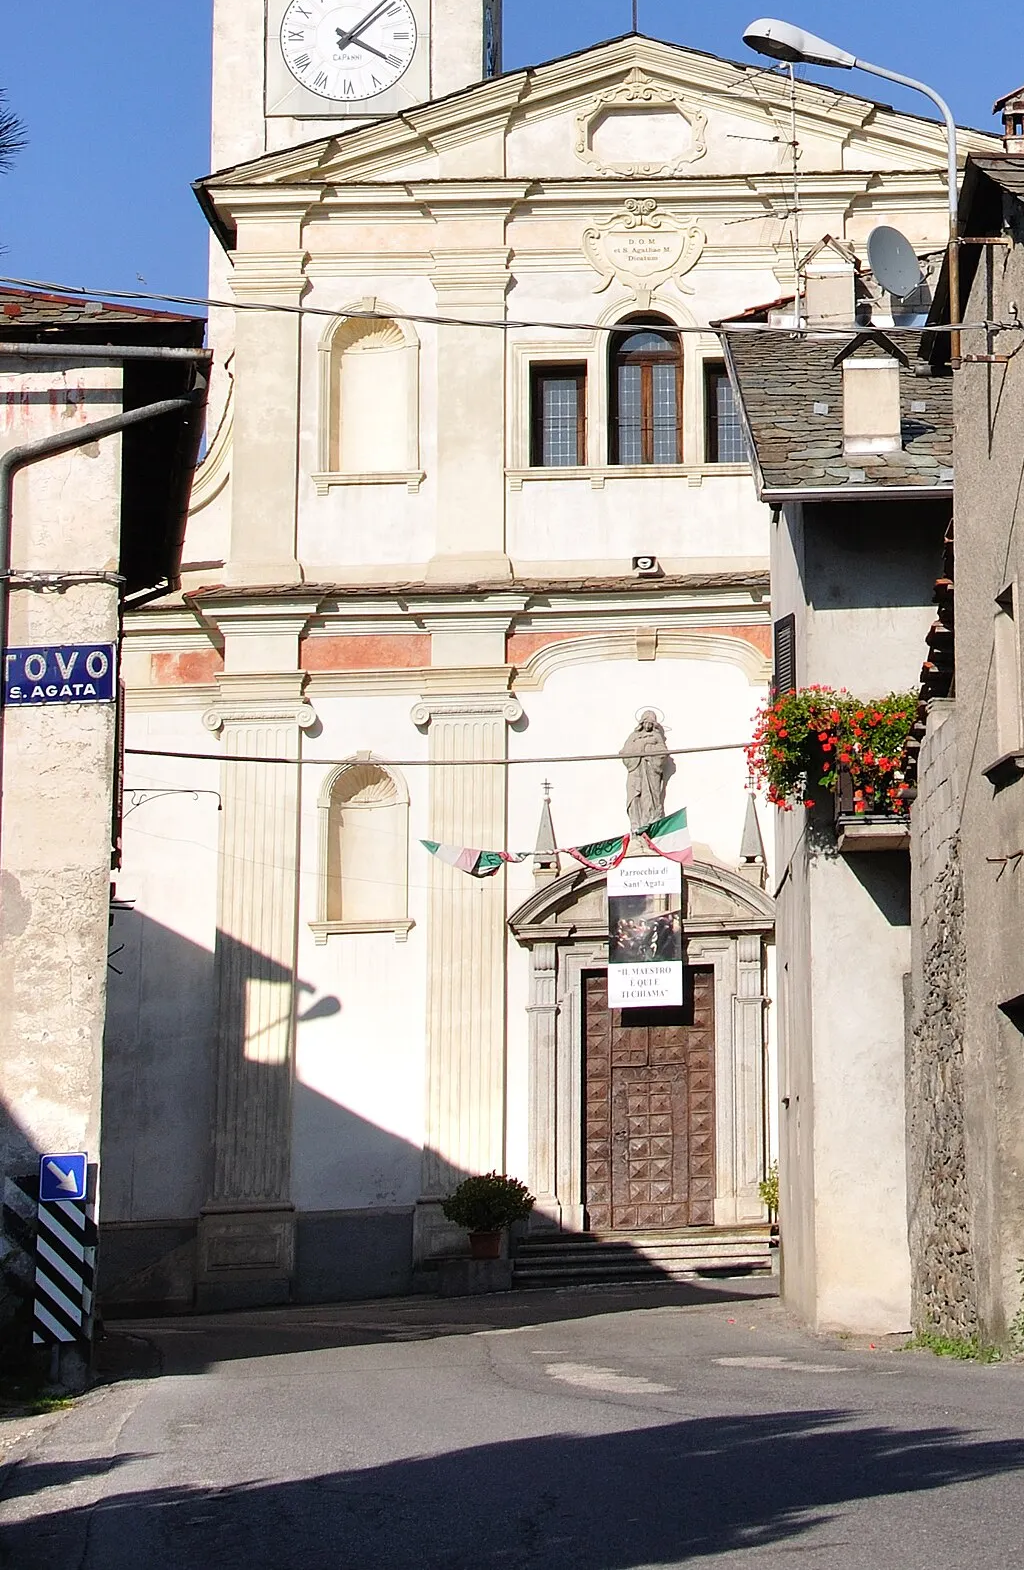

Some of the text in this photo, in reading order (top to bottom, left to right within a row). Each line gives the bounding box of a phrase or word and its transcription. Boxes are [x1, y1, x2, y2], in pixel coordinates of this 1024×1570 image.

[295, 5, 312, 19] X
[287, 30, 305, 41] IX
[393, 32, 409, 40] III
[293, 53, 311, 73] VIII
[313, 70, 328, 90] VII
[343, 78, 355, 95] VI
[9, 683, 97, 699] S. AGATA
[620, 866, 669, 877] Parrocchia di
[632, 966, 672, 975] MAESTRO
[637, 978, 653, 987] QUI
